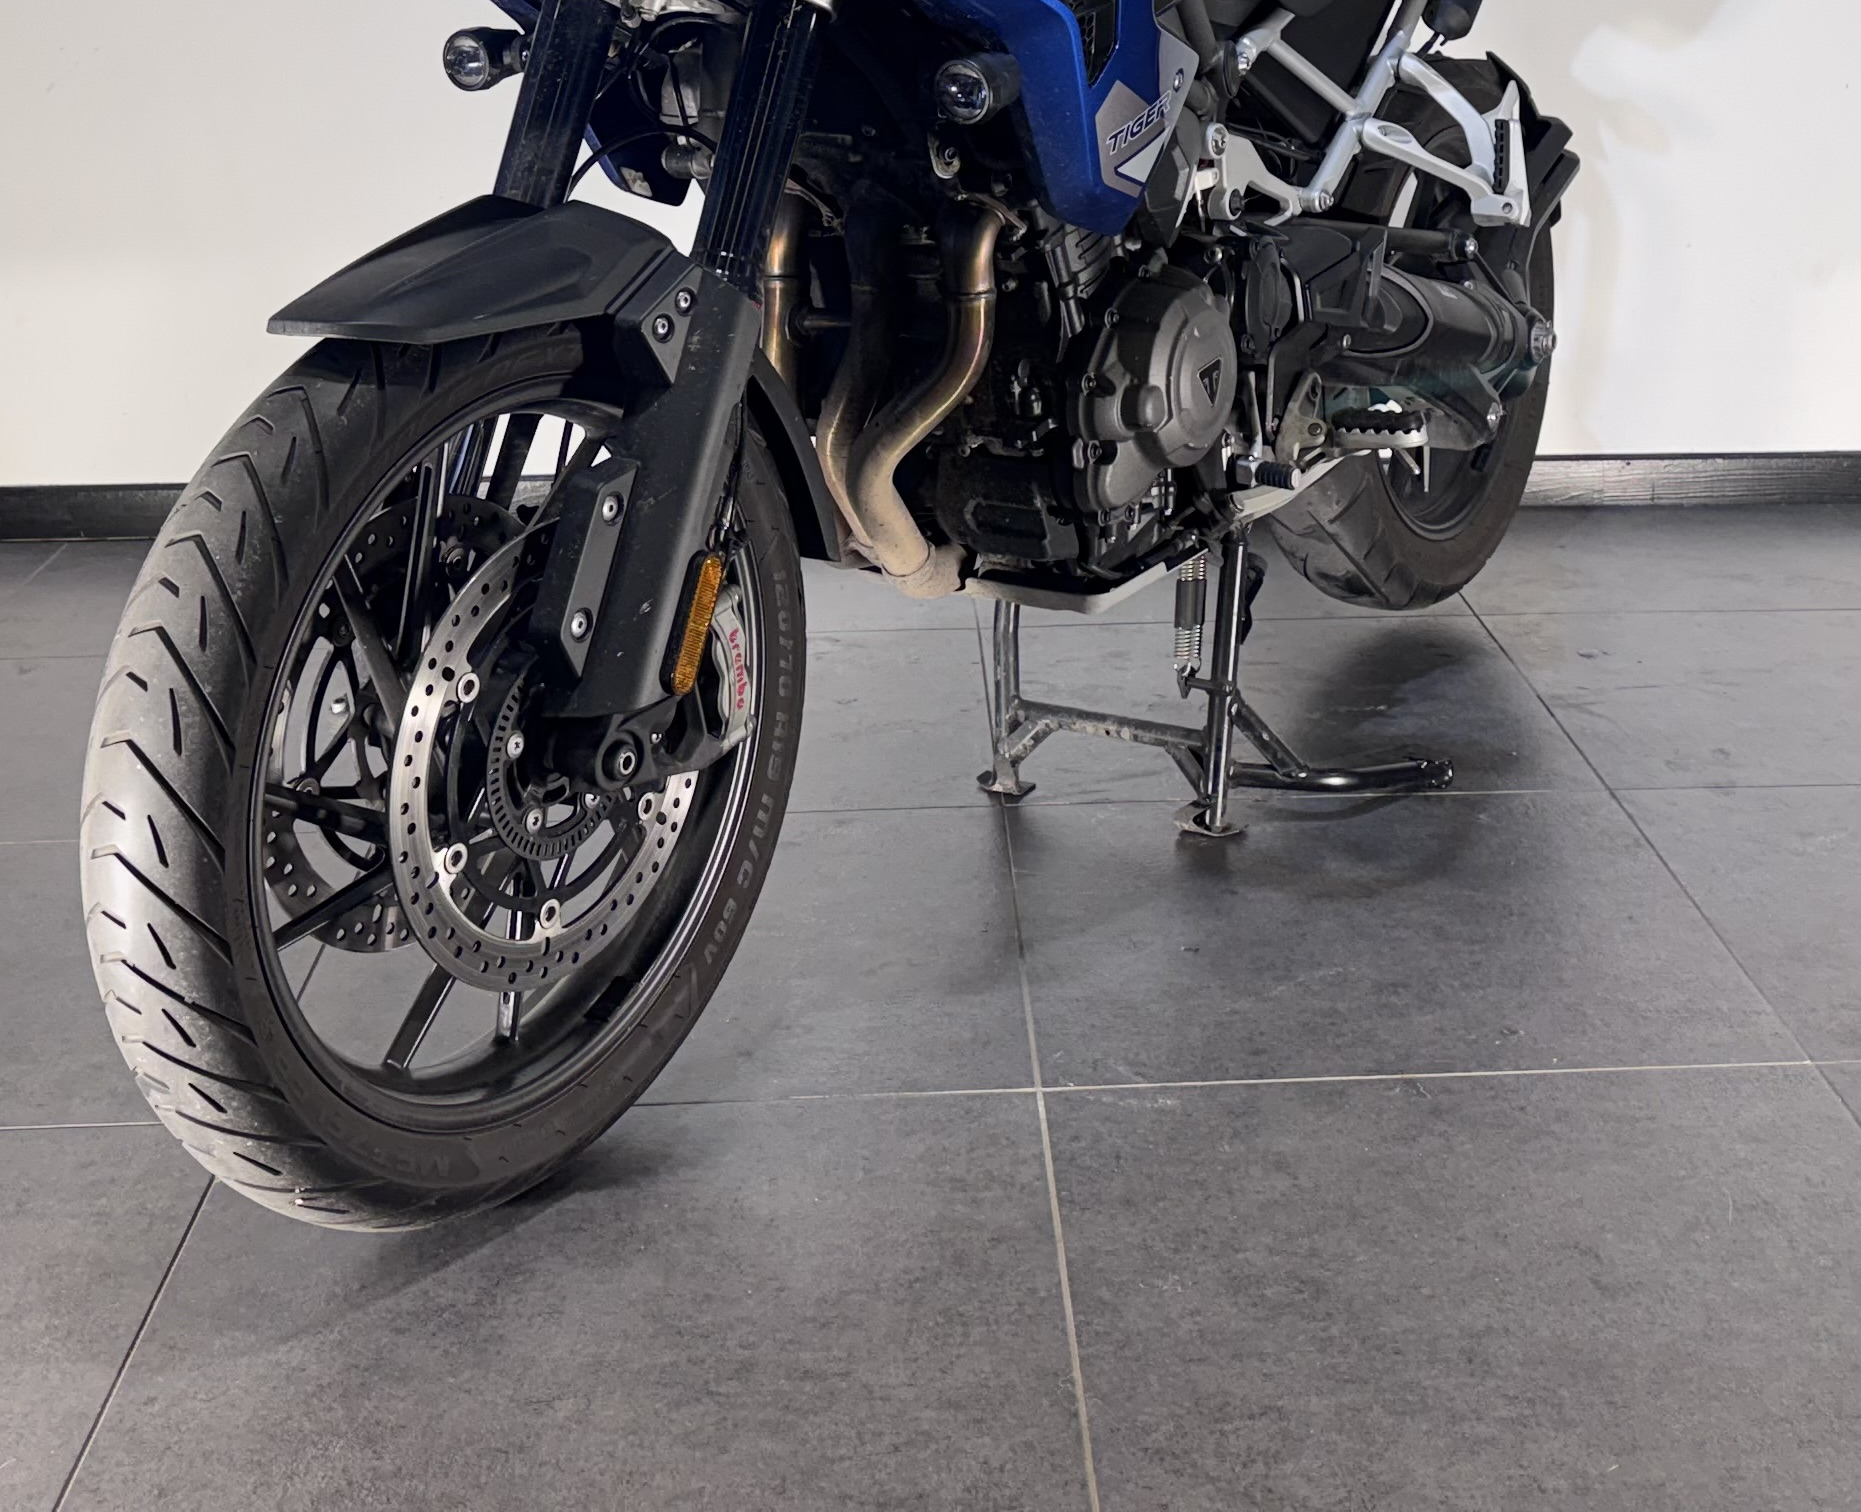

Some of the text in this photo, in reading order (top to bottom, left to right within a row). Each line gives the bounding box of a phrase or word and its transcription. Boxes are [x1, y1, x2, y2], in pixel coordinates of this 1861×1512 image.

[1106, 89, 1171, 155] TIGER
[729, 627, 749, 710] brembo
[701, 569, 794, 967] 120/70 R19 M/C 60V
